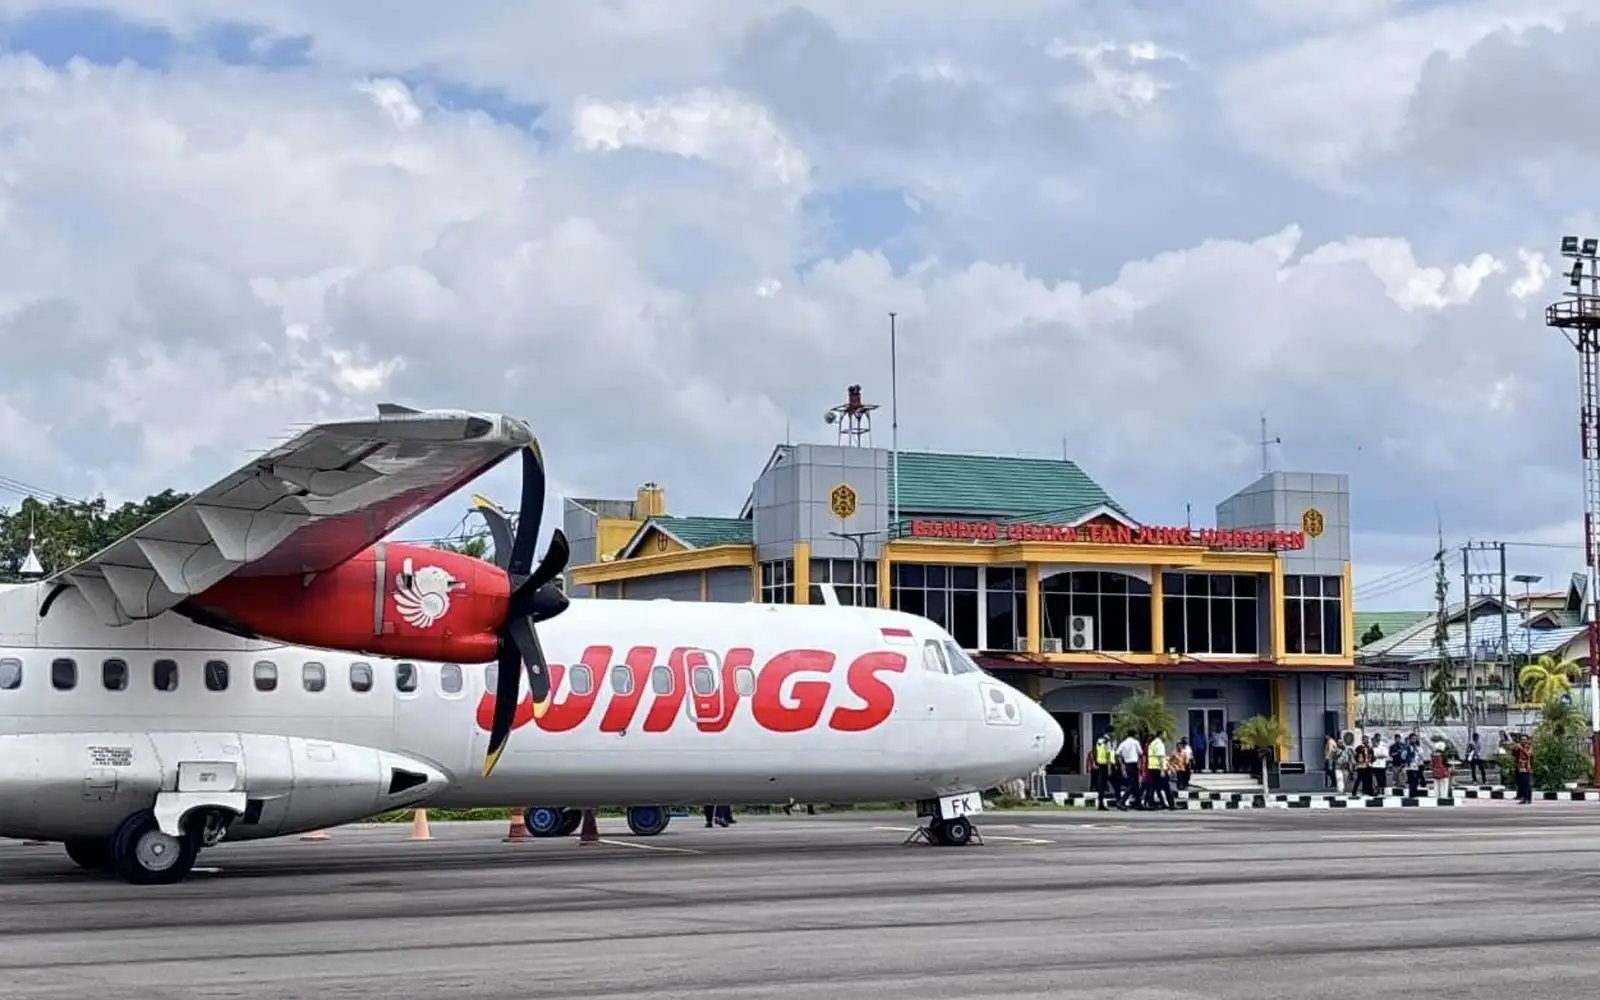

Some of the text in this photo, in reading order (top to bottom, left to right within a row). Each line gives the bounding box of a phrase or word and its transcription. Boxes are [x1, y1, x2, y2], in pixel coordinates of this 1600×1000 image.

[1087, 523, 1192, 545] TANJUNG
[476, 645, 907, 733] WINGS
[951, 798, 972, 815] FK
